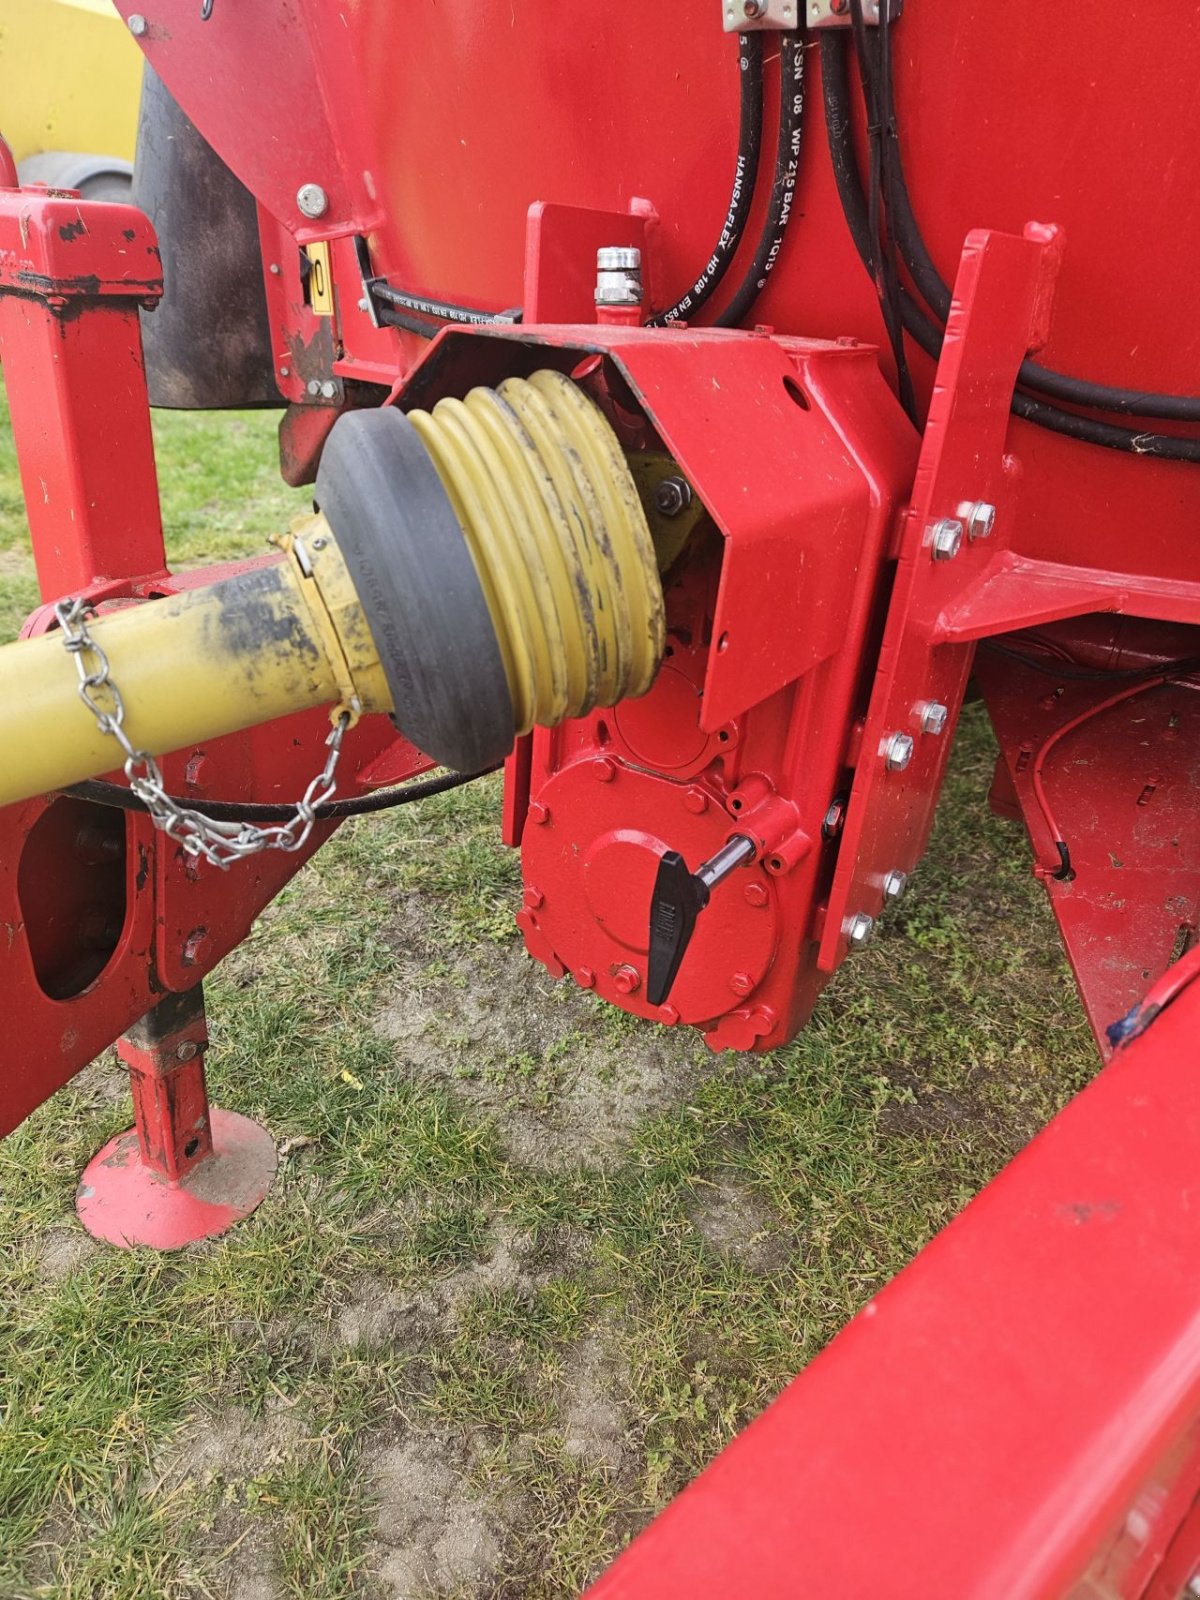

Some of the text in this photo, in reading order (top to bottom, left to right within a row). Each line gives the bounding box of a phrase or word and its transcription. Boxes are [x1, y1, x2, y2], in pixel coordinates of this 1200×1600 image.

[793, 94, 803, 115] 08
[791, 128, 802, 155] WP
[786, 160, 797, 188] 215
[718, 156, 745, 250] HANSA-FLEX
[778, 193, 793, 226] BAR
[707, 254, 719, 275] HD
[764, 237, 782, 271] 1Q15
[694, 275, 708, 294] 108
[679, 296, 692, 312] EN
